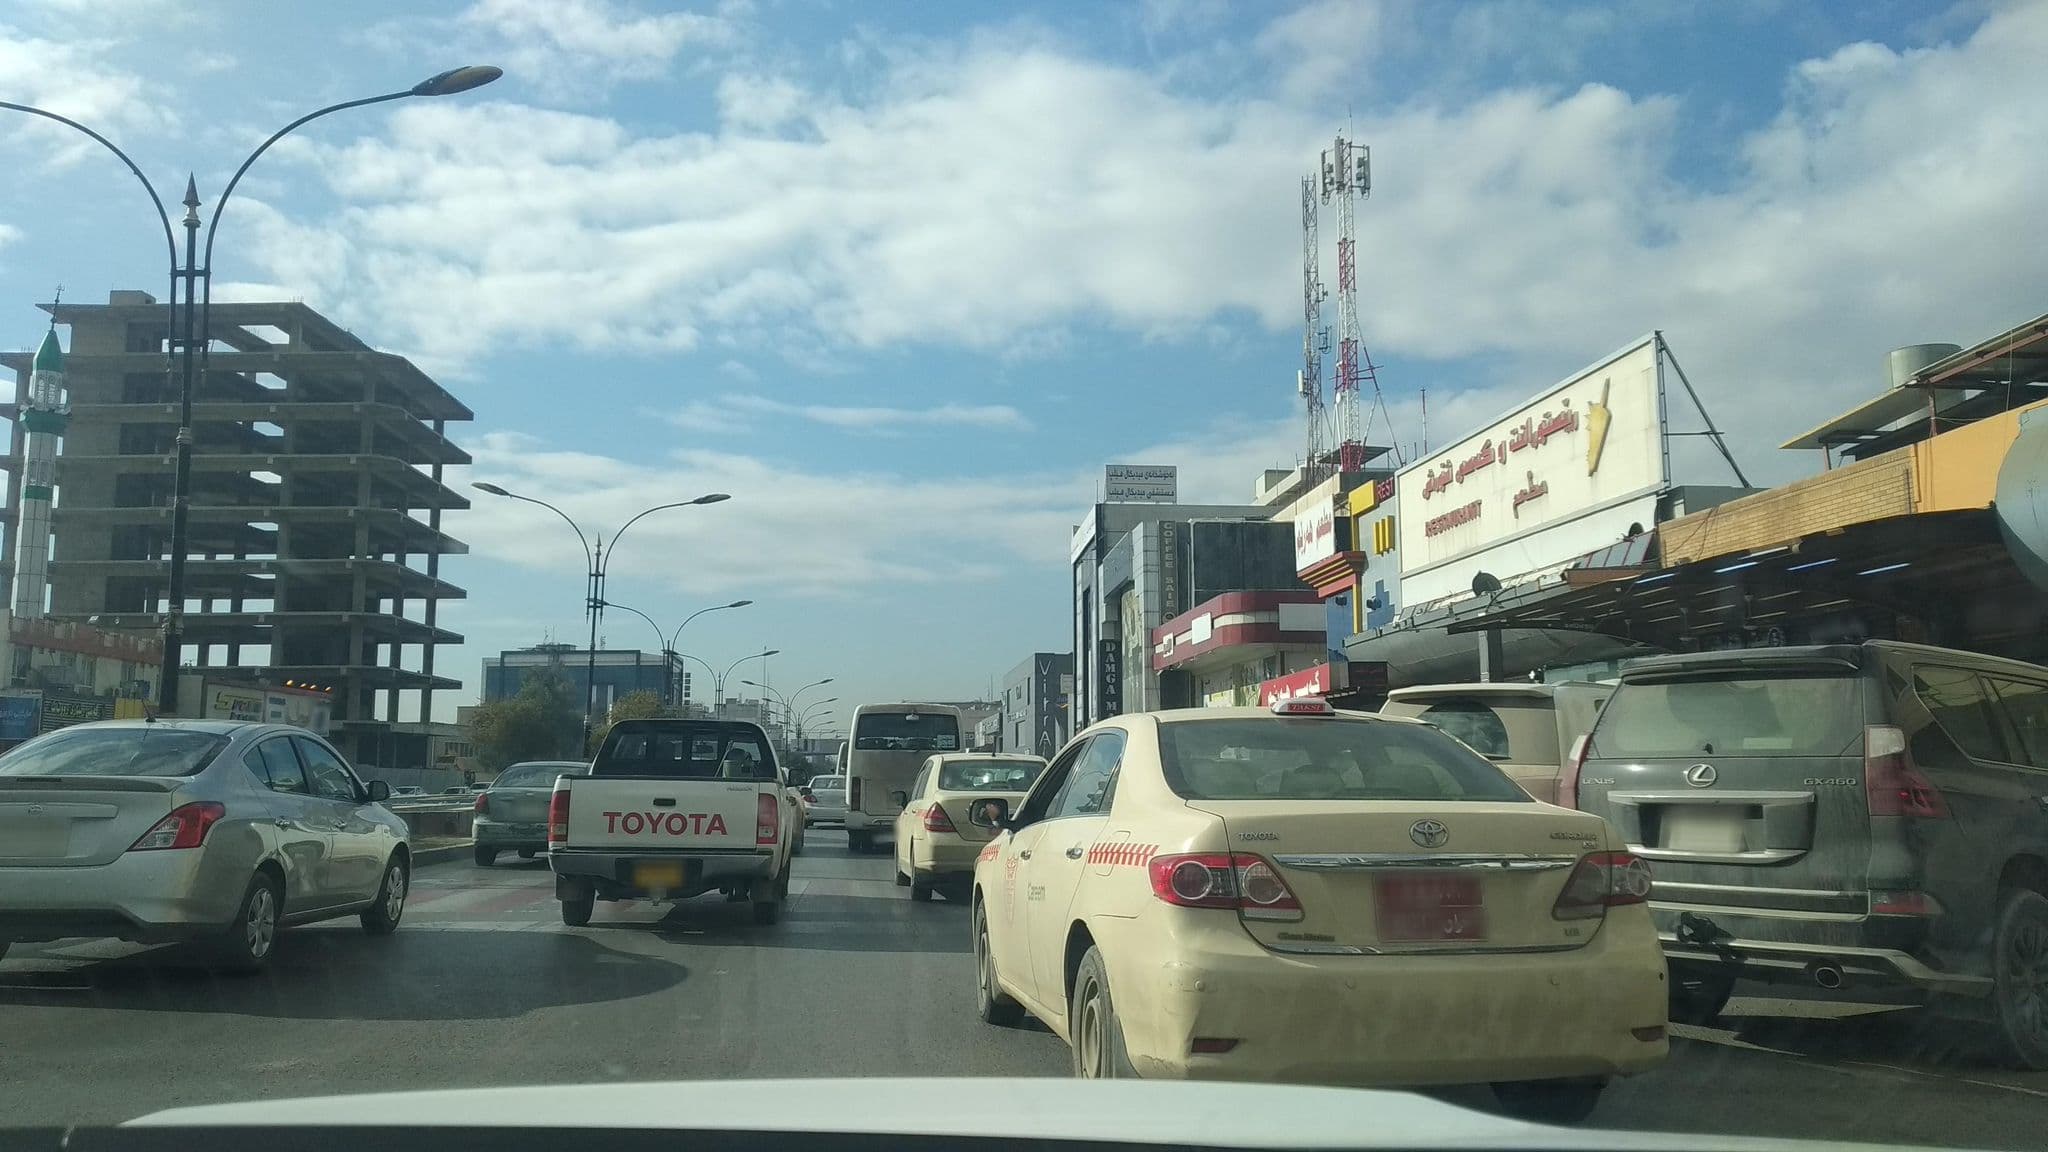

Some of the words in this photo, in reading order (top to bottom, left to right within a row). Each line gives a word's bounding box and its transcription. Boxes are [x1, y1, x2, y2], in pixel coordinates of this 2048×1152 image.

[1512, 470, 1548, 519] مطعم
[1105, 641, 1117, 695] DAMGA
[1582, 777, 1615, 785] LEXUS
[603, 811, 728, 836] TOYOTA
[1238, 831, 1280, 841] TOYOTA
